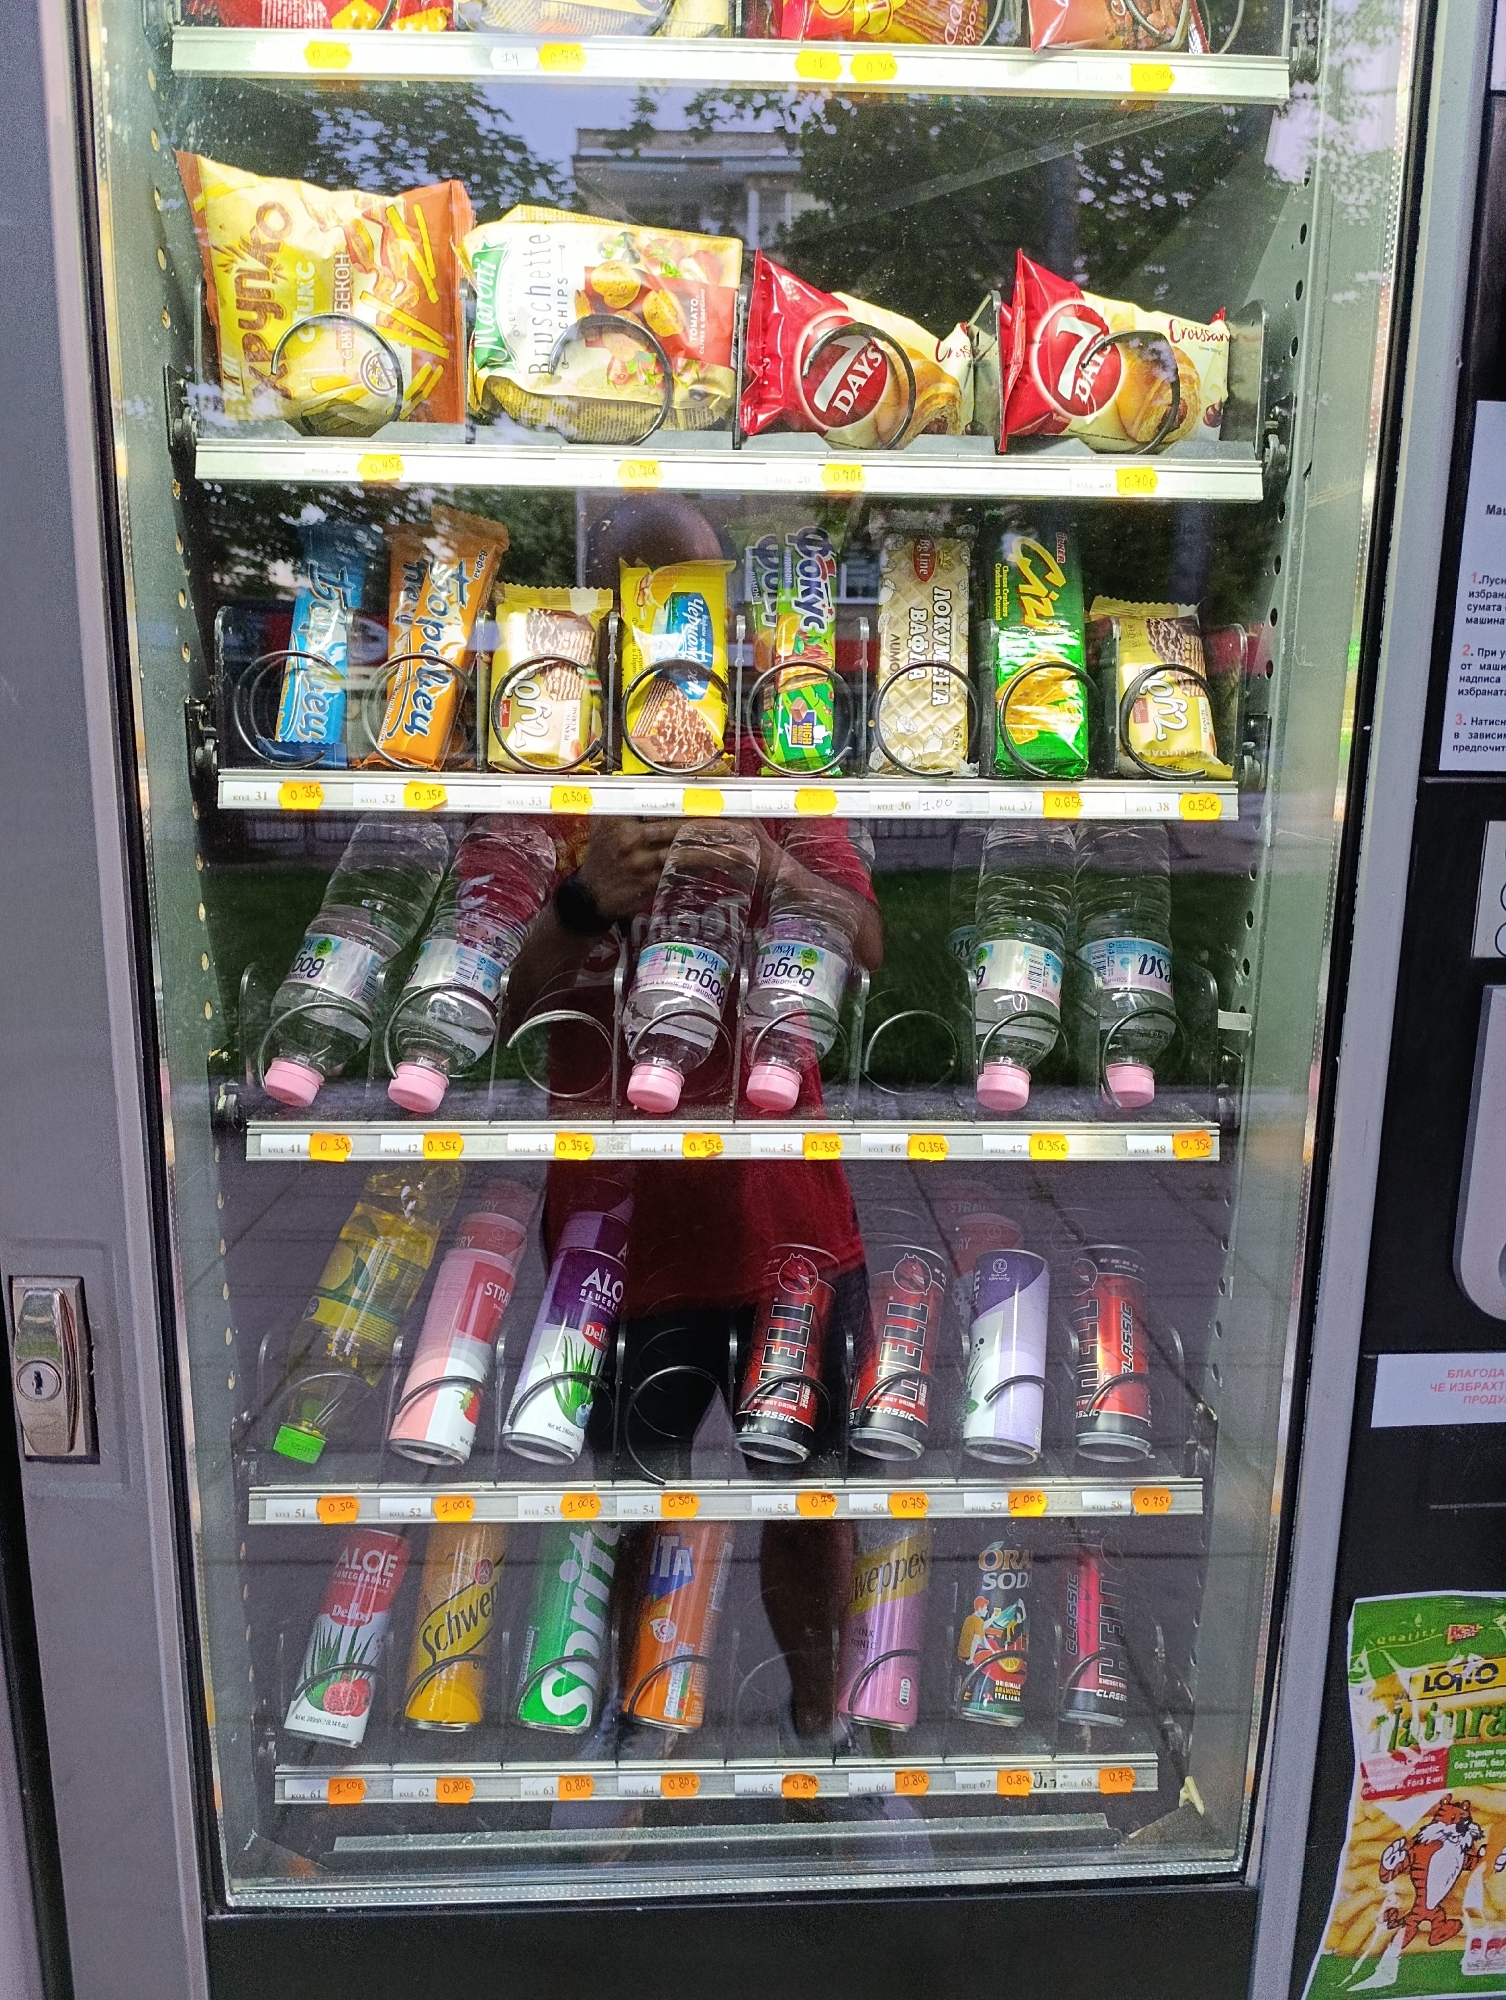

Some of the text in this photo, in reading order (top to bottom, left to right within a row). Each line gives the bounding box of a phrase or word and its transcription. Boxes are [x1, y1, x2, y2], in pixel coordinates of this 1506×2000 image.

[333, 251, 351, 314] БЕКОН
[522, 233, 552, 375] Bruschette
[556, 276, 569, 330] CHIPS
[689, 294, 699, 343] TOMATO,
[1055, 316, 1102, 401] 7
[832, 344, 883, 416] DAYS
[1124, 475, 1155, 488] 0.70€
[1055, 531, 1067, 564] ÜLKER
[917, 538, 930, 576] Bg Line
[472, 549, 489, 580] вафла
[783, 555, 793, 584] ЛИМОН
[749, 570, 761, 599] ЛИМОН
[785, 527, 838, 633] Фокус
[1466, 602, 1502, 613] сумата
[402, 557, 473, 737] Боровец
[907, 608, 929, 682] ВАФЛА
[931, 586, 952, 707] ЛОКУМЕНА
[1462, 643, 1497, 659] 2. При
[1460, 662, 1472, 671] от
[1459, 675, 1501, 684] надписа
[1455, 712, 1467, 726] 3.
[803, 722, 813, 746] HIGH
[1453, 732, 1460, 740] в
[254, 786, 321, 801] 31 0.35€
[382, 788, 442, 804] 32 0.35€
[528, 790, 589, 806] 33 0.50€
[661, 798, 676, 809] 34
[777, 799, 790, 810] 35
[897, 798, 952, 812] 36 1.00
[1020, 796, 1084, 811] 37 0.65€
[1156, 799, 1217, 812] 38 0.50€
[772, 944, 796, 957] Vesa
[696, 951, 720, 971] Vesa
[762, 956, 816, 988] Boga
[684, 966, 726, 1007] Boga
[289, 1143, 300, 1153] 41
[405, 1140, 458, 1153] 42 0.35€
[535, 1139, 591, 1153] 43 0.35€
[661, 1139, 722, 1153] 44 0.35€
[780, 1143, 794, 1153] 45
[888, 1140, 946, 1153] 46 0.35€
[1010, 1139, 1066, 1154] 47 0.35€
[1153, 1139, 1212, 1154] 48 0.35€
[1430, 1382, 1446, 1393] ЧЕ
[778, 1400, 797, 1411] DRINK
[898, 1398, 916, 1410] DRINK
[750, 1409, 796, 1424] CLASSIC
[869, 1405, 916, 1421] CLASSIC
[409, 1507, 422, 1518] 52
[543, 1504, 556, 1516] 53
[643, 1504, 655, 1515] 54
[777, 1503, 789, 1513] 55
[872, 1503, 884, 1512] 56
[990, 1501, 1003, 1511] 57
[1111, 1501, 1123, 1510] 58
[294, 1507, 307, 1519] 51
[335, 1545, 399, 1578] ALOE
[333, 1570, 391, 1588] POMEGRANATE
[1065, 1571, 1079, 1656] CLASSIC
[543, 1779, 590, 1795] 63 0.80€
[761, 1782, 774, 1792] 65
[875, 1782, 887, 1792] 66
[979, 1778, 991, 1788] 67
[1081, 1777, 1093, 1786] 68
[310, 1789, 321, 1799] 61
[418, 1782, 471, 1798] 62 0.80€
[642, 1785, 654, 1794] 64
